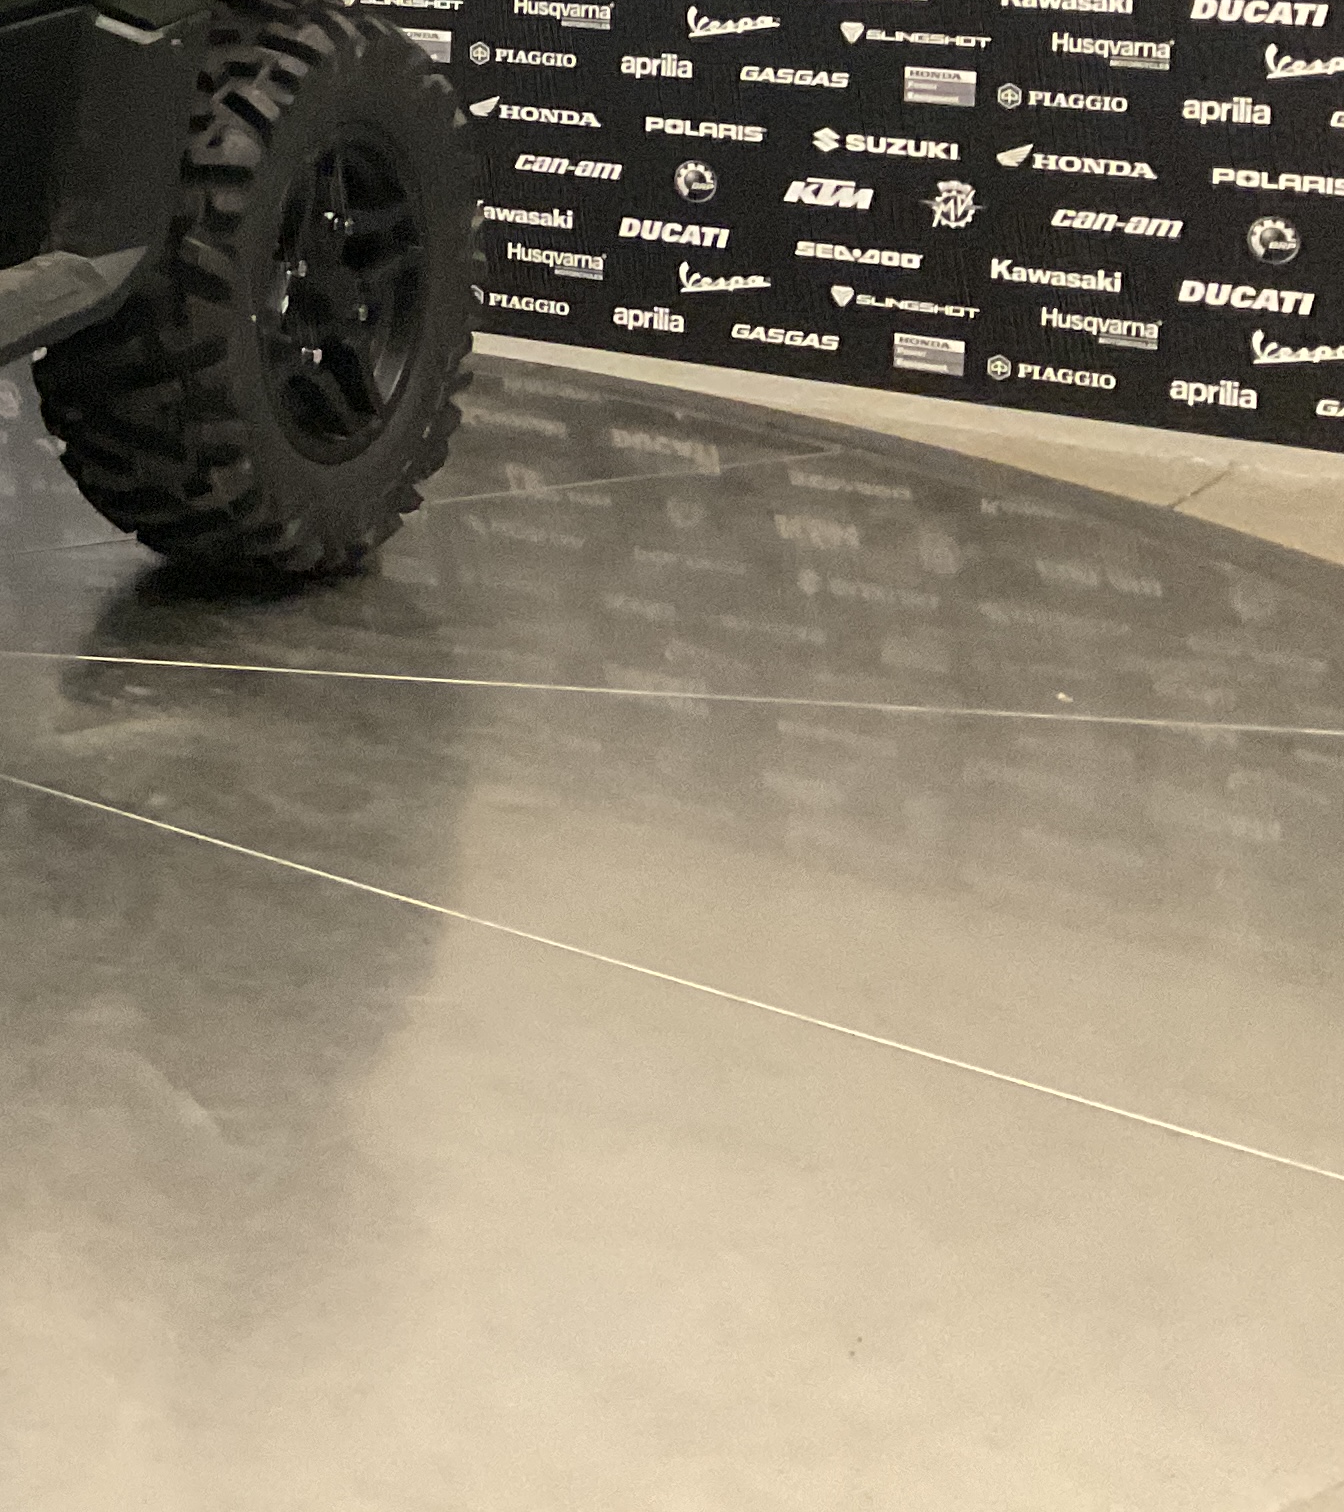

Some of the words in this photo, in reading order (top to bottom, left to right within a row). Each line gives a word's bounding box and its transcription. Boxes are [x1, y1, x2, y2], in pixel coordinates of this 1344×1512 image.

[687, 6, 780, 38] Vespa
[866, 29, 991, 48] SLINGSHOT
[1052, 32, 1171, 64] Husqvarna
[495, 48, 576, 68] PIAGGIO
[621, 53, 692, 78] aprilia
[740, 66, 849, 88] GASGAS
[1028, 91, 1127, 112] PIAGGIO
[1182, 97, 1271, 125] aprilia
[501, 105, 601, 127] HONDA
[645, 117, 767, 142] POLARIS
[846, 134, 960, 160] SUZUKI
[515, 154, 622, 180] can-am
[1035, 154, 1157, 179] HONDA
[784, 177, 874, 209] KTM
[477, 199, 573, 229] awasaki
[1051, 209, 1183, 239] can-am
[619, 217, 729, 248] DUCATI
[507, 242, 603, 275] Husqvarna
[679, 261, 771, 292] Vespa
[991, 258, 1121, 293] Kawasaki
[489, 293, 569, 315] PIAGGIO
[856, 294, 980, 318] SLINGSHOT
[1178, 280, 1315, 315] DUCATI
[613, 307, 684, 332] aprilia
[1041, 307, 1158, 344] Husqvarna
[731, 324, 839, 350] GASGAS
[1018, 363, 1116, 389] PIAGGIO
[1170, 380, 1257, 409] aprilia
